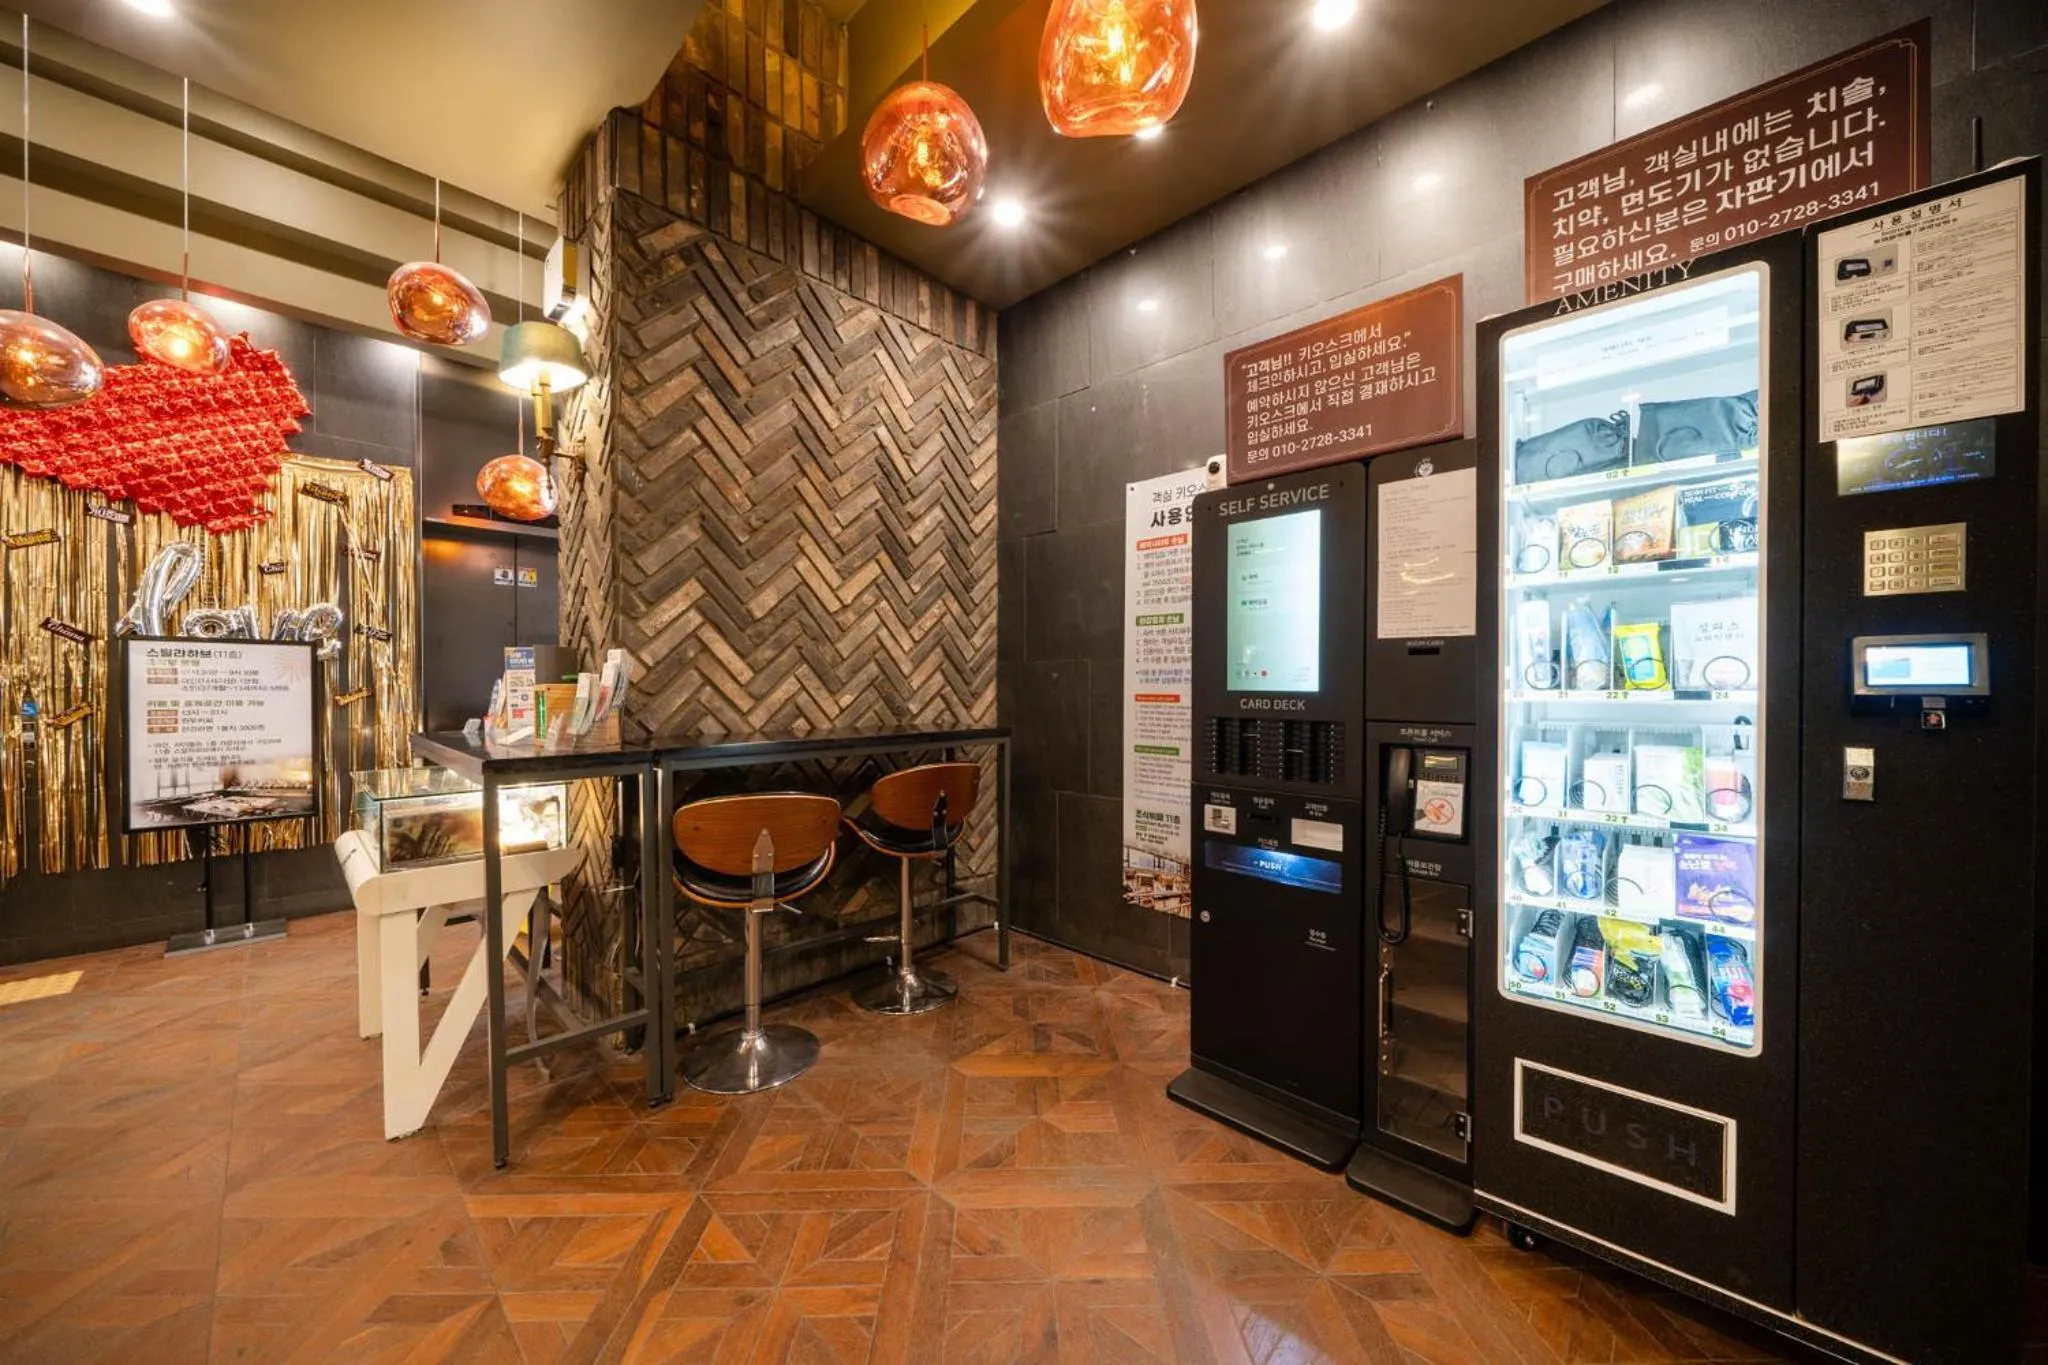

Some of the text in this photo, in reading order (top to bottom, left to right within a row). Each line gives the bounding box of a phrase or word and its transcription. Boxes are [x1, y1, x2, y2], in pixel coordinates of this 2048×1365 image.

[1552, 76, 1887, 212] 고객님, 객실내에는 치솔,
[1553, 107, 1886, 239] 치약, 면도기가 없습니다.
[1553, 141, 1873, 267] 필요하신분은 자판기에서
[1553, 243, 1676, 293] 구매하세요.
[1690, 232, 1720, 253] 문의
[1725, 181, 1879, 240] 010-2728-3341
[1554, 259, 1699, 316] AMENITY
[1299, 322, 1382, 362] 키오스크에서
[1247, 351, 1421, 413] 예약하시지 않으신 고객님은
[1247, 400, 1322, 429] 키오스크에서
[1327, 391, 1353, 408] 직접
[1247, 419, 1313, 446] 입실하세요.
[1248, 424, 1373, 463] 문의 010-2728-3341
[1219, 484, 1329, 517] SELF SERVICE
[1240, 698, 1306, 711] CARD DECK
[1259, 860, 1282, 872] PUSH
[1656, 1014, 1669, 1023] 53
[1543, 1094, 1697, 1167] PUSH
